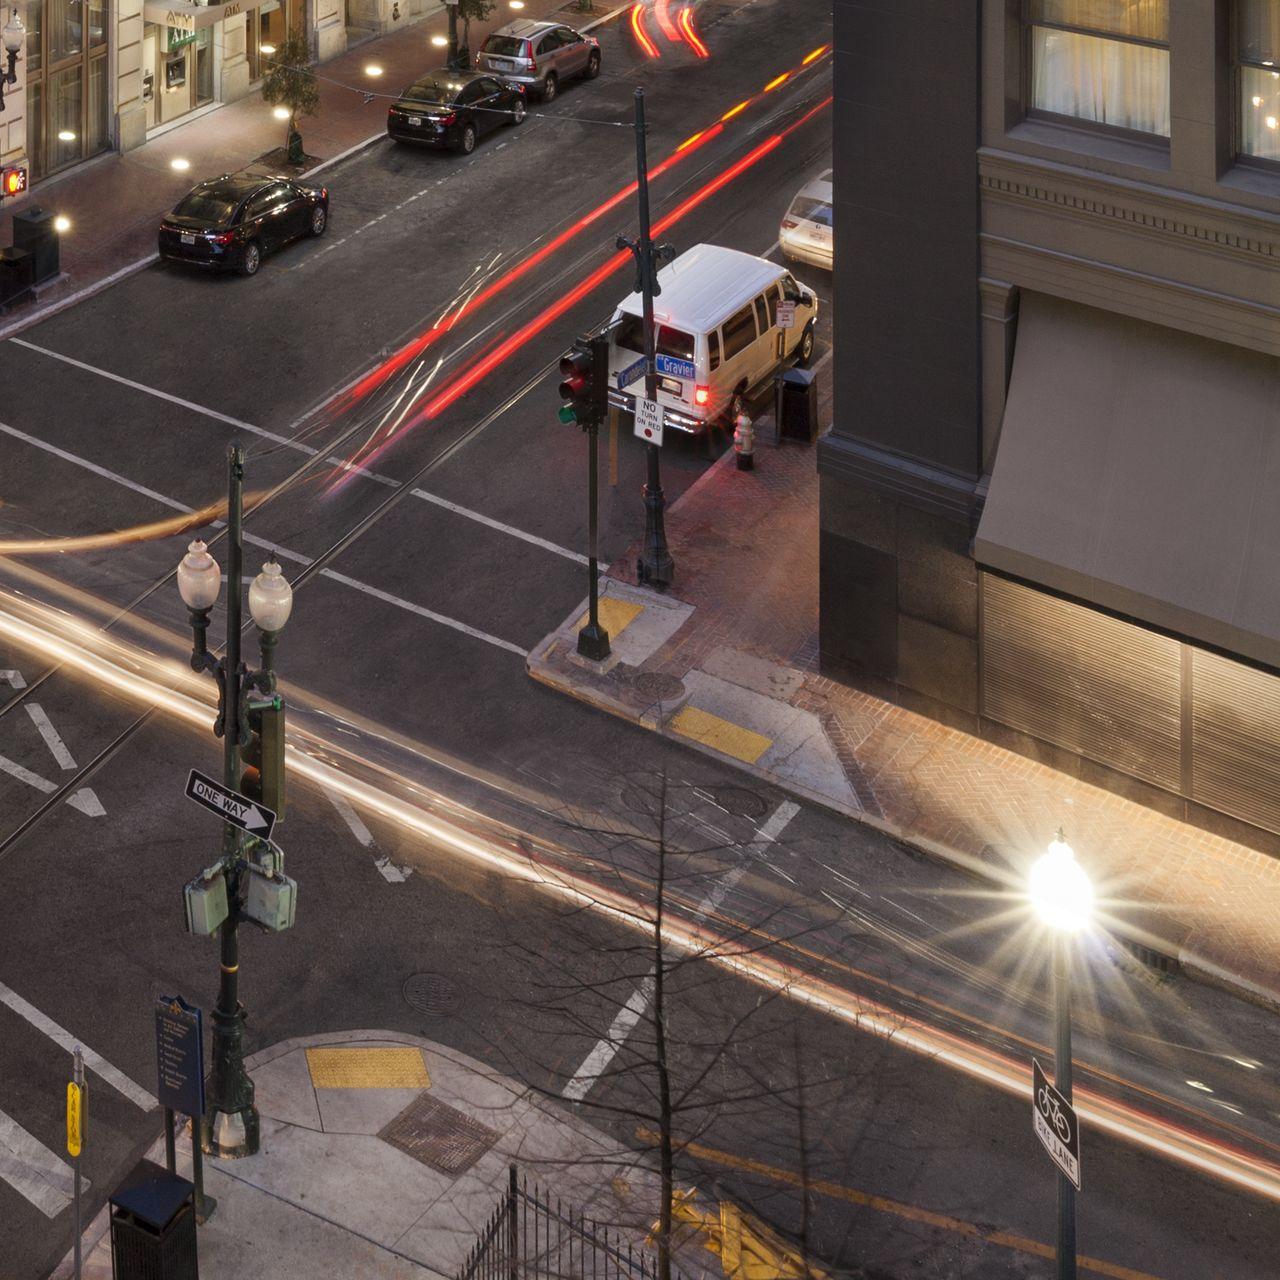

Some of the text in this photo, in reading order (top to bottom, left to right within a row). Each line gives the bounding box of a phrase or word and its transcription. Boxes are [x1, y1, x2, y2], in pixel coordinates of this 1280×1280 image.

[223, 3, 241, 18] ATM
[663, 357, 694, 377] Gravier
[642, 401, 656, 412] NO
[641, 410, 658, 421] TURN
[637, 417, 661, 431] ON RED
[196, 783, 248, 818] ONE WAY
[1053, 1139, 1074, 1175] LANE
